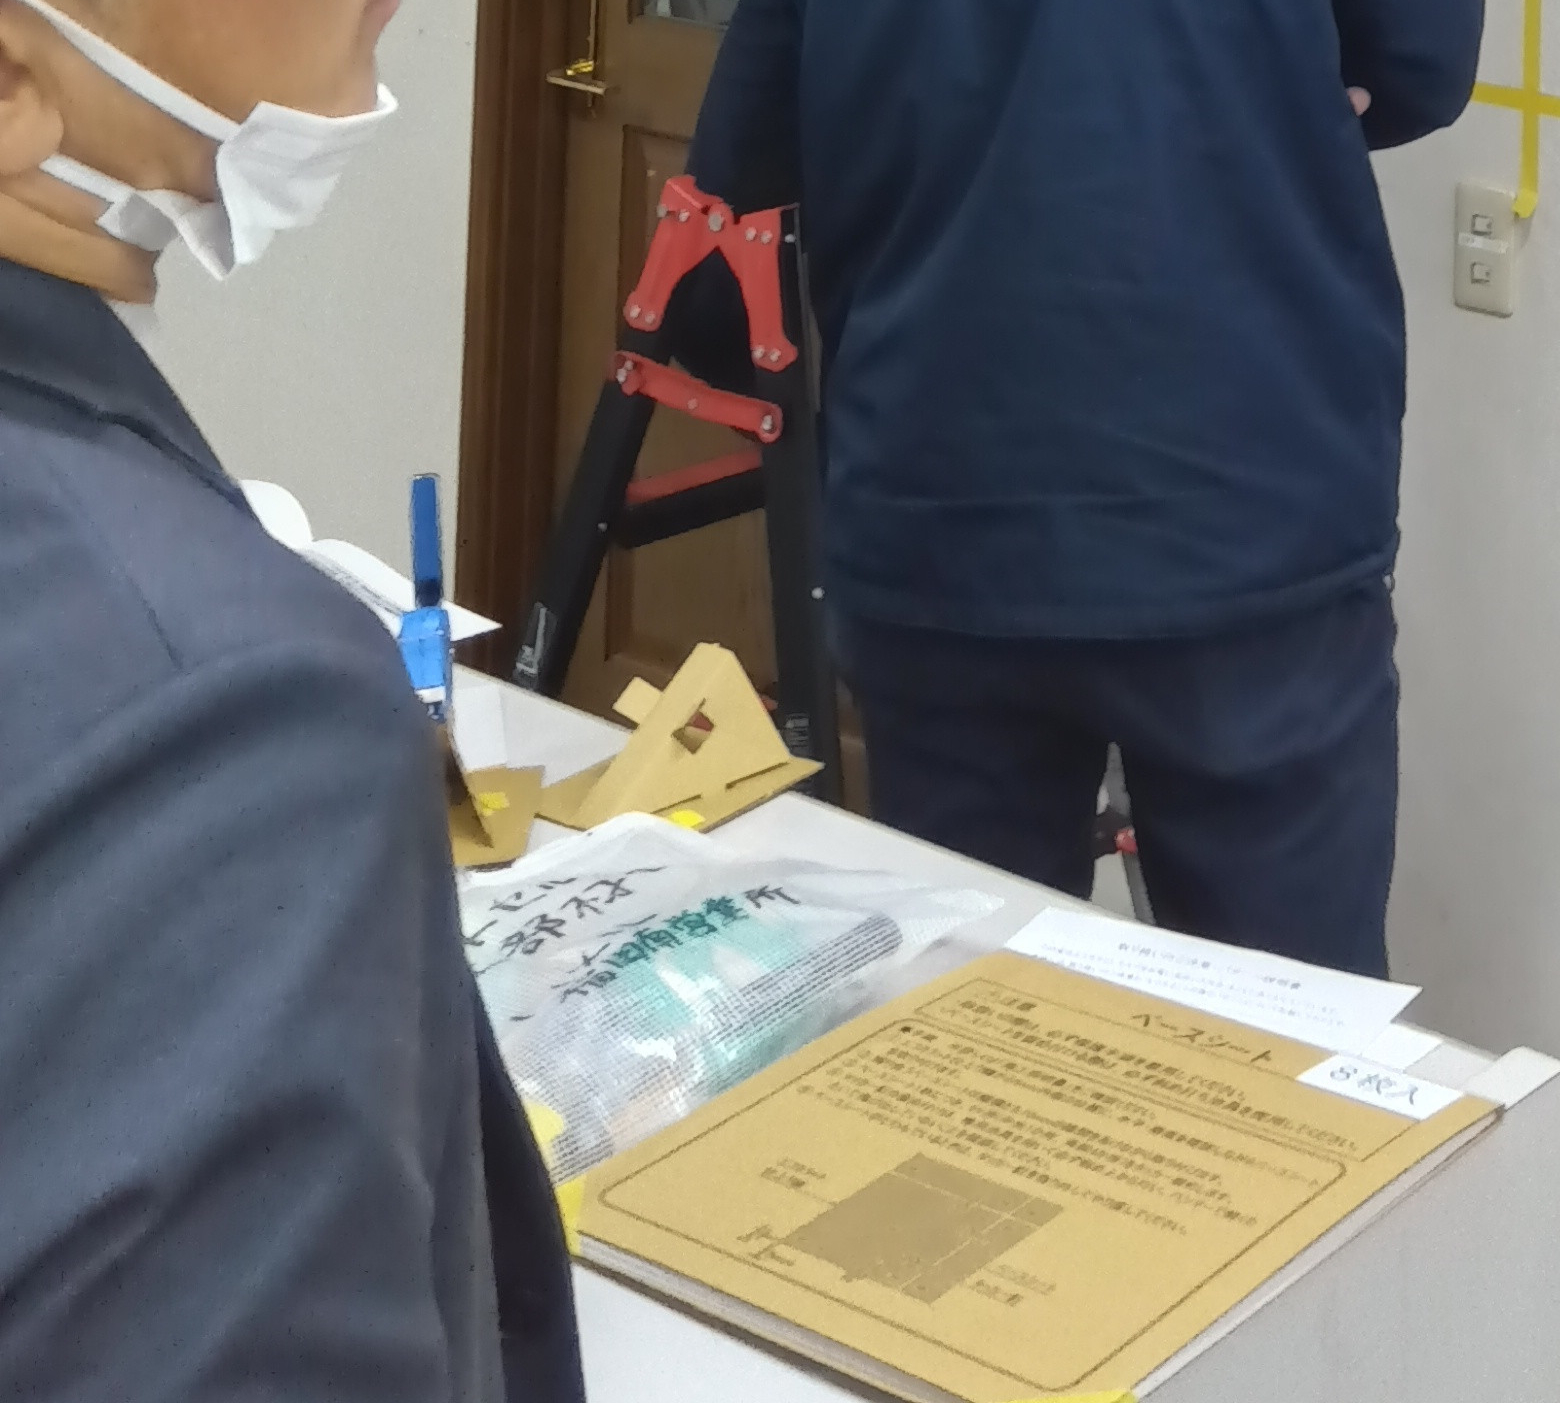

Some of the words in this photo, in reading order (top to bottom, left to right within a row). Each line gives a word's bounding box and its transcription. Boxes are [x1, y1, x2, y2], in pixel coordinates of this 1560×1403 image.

[1131, 1012, 1272, 1064] ベースシート
